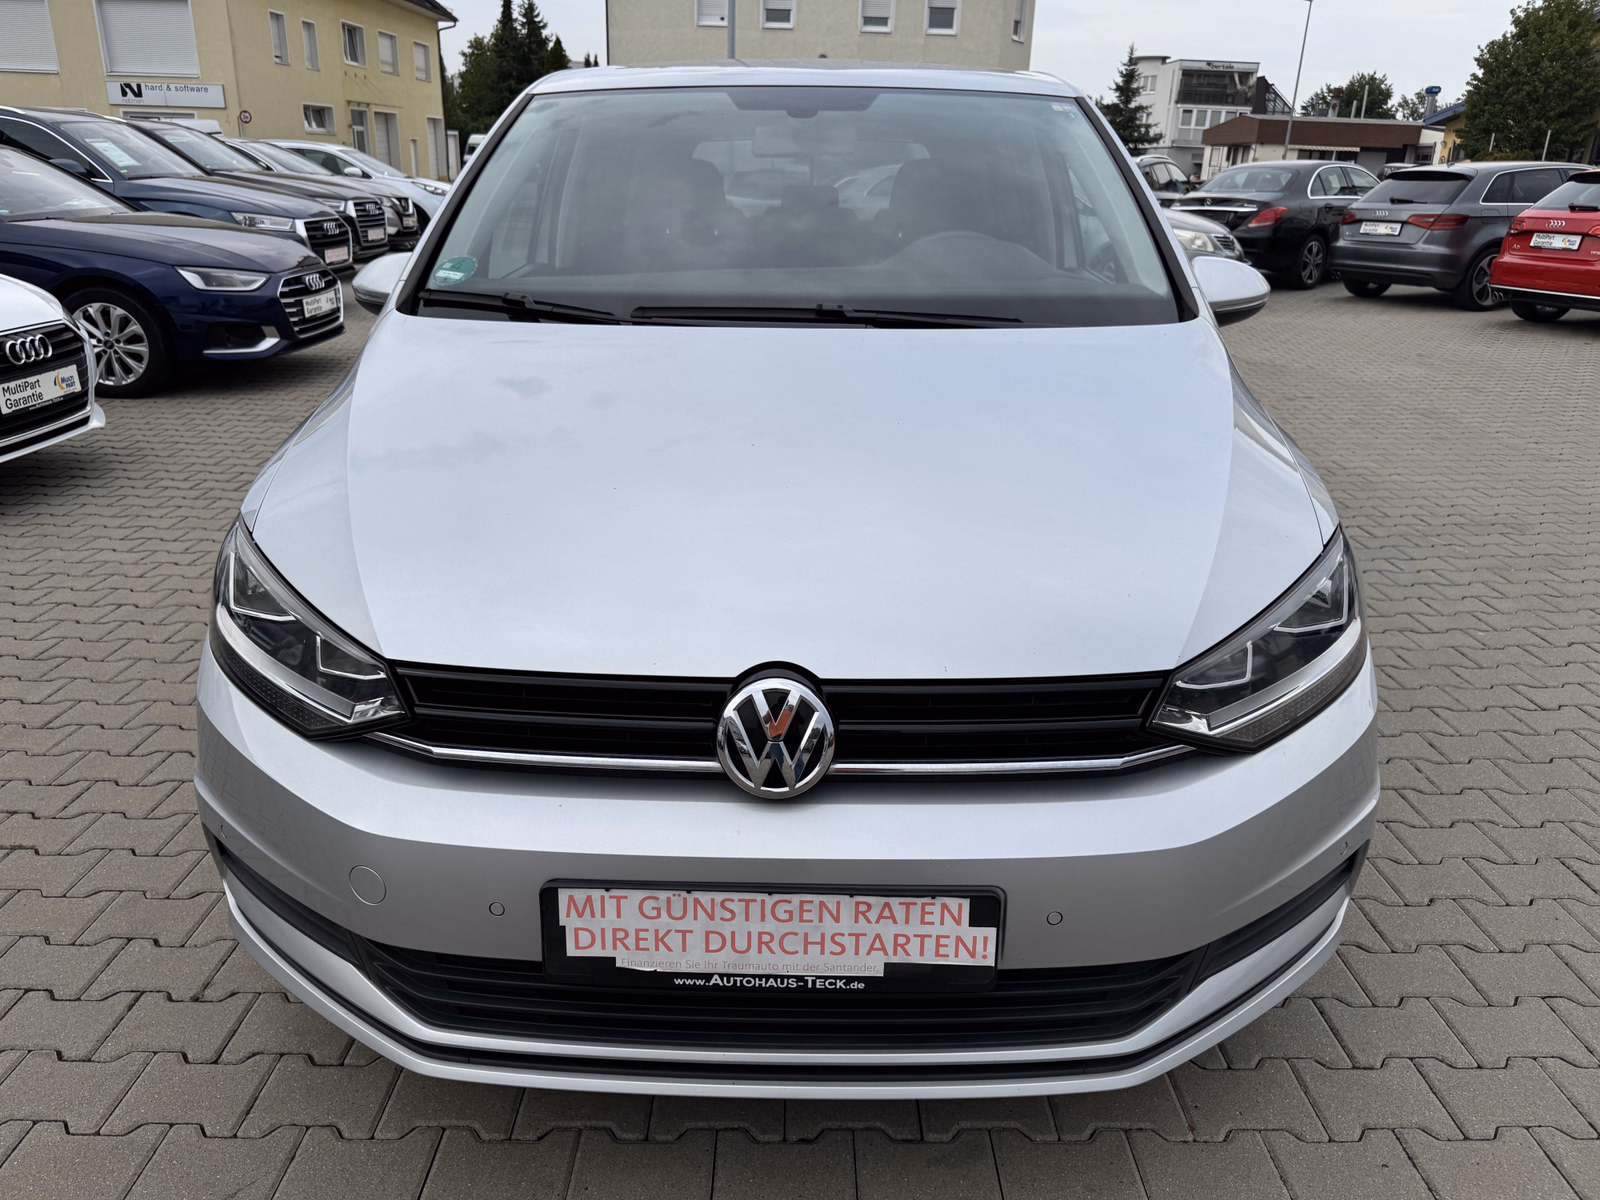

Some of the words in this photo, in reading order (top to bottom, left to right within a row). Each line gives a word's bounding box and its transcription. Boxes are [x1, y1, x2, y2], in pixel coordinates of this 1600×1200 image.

[144, 83, 163, 91] hard
[166, 84, 172, 92] &
[174, 84, 209, 93] software
[2, 378, 41, 397] MultiPart
[5, 391, 44, 410] Garantie
[565, 894, 628, 919] MIT
[637, 893, 841, 924] GÜNSTIGEN
[853, 901, 963, 926] RATEN
[573, 927, 694, 953] DIREKT
[704, 930, 989, 960] DURCHSTARTEN!
[621, 957, 682, 969] Finanzieren
[685, 959, 701, 969] Sie
[704, 960, 718, 970] Ihr
[722, 960, 779, 971] Traumauto
[782, 962, 800, 972] mit
[802, 962, 820, 972] der
[823, 963, 879, 973] Santander.
